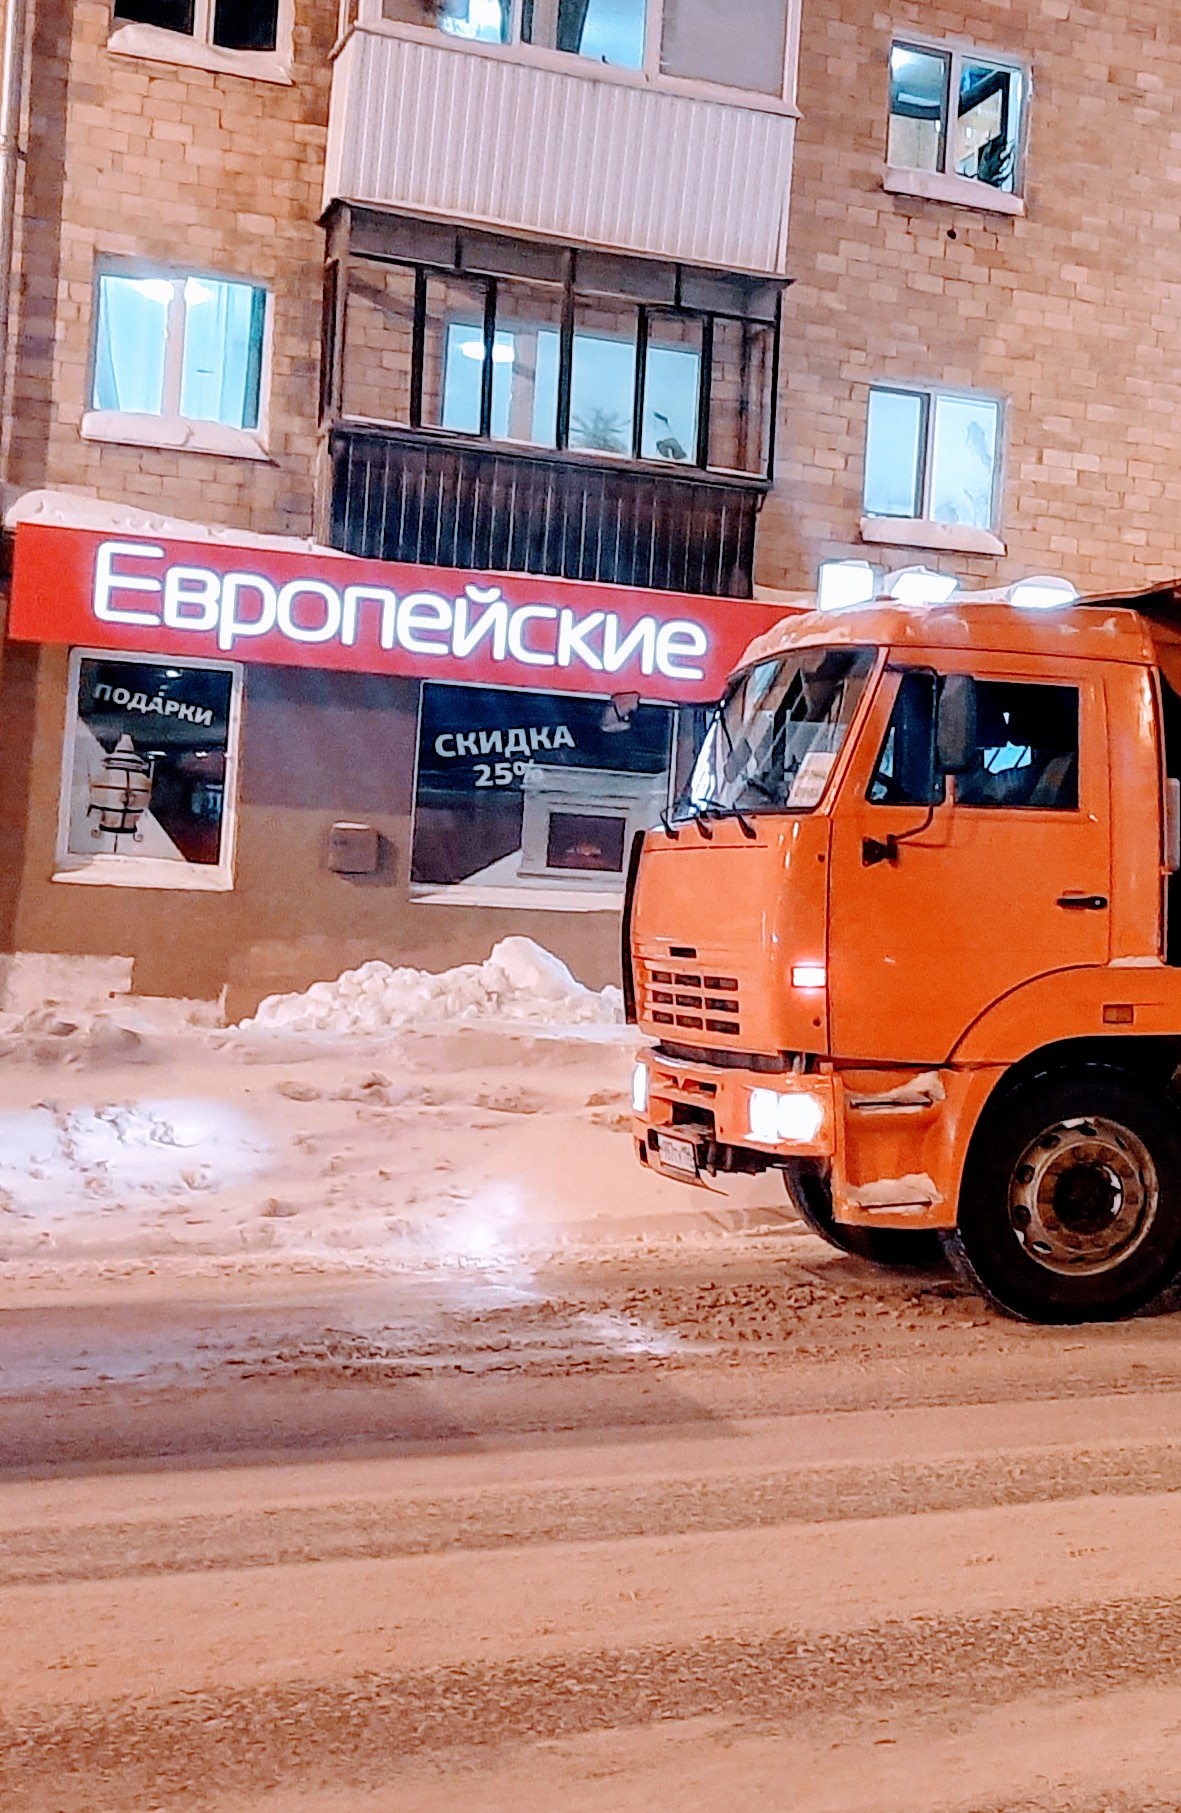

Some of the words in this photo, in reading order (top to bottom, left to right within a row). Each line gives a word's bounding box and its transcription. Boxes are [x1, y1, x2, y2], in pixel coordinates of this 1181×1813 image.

[92, 541, 708, 680] Европейские
[93, 683, 214, 727] ПОДАРКИ
[434, 725, 576, 759] СКИДКА
[472, 758, 545, 788] 25%
